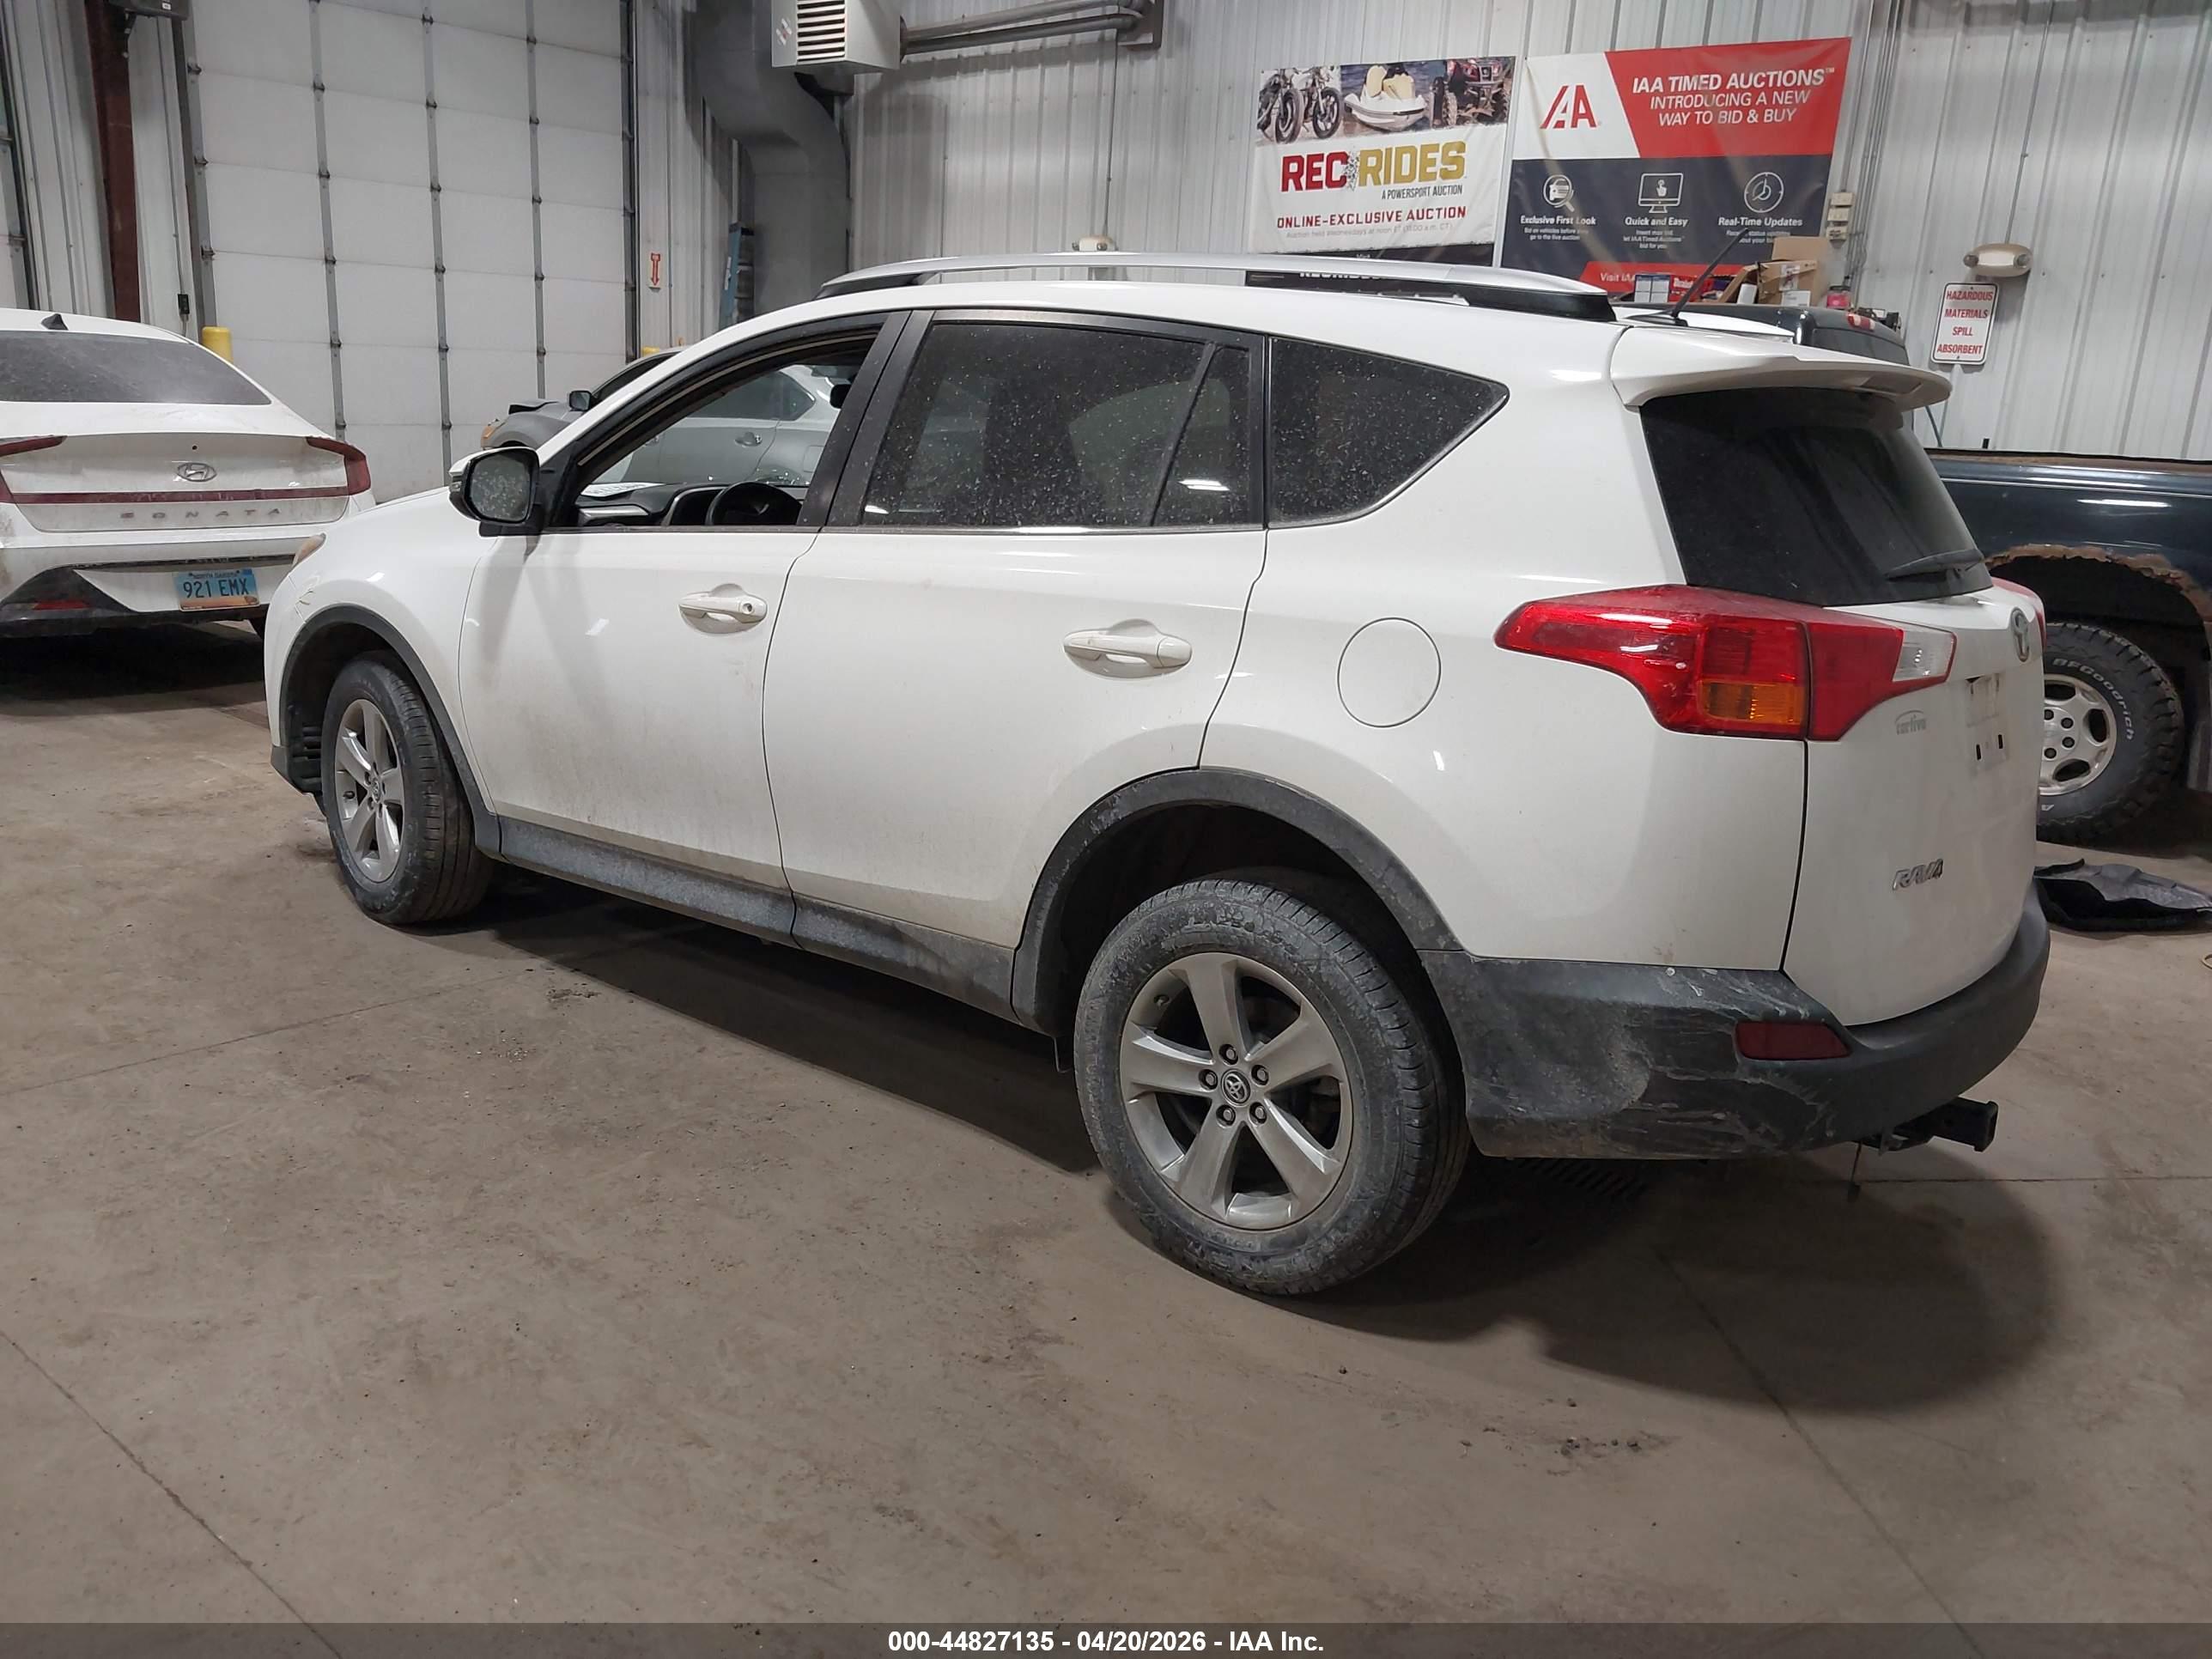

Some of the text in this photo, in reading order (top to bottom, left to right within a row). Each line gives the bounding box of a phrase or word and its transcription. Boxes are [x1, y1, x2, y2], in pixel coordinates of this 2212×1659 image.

[1632, 76, 1664, 94] IAA
[1668, 74, 1723, 92] TIMED
[1650, 89, 1812, 110] INTRODUCING A NEW
[1659, 107, 1797, 126] WAY TO BID & BUY
[1281, 141, 1468, 192] REC RIDES
[1387, 186, 1431, 200] POWERSPORT
[1432, 185, 1463, 197] AUCTION
[1277, 209, 1402, 229] ONLINE-EXCLUSIVE
[1405, 205, 1468, 222] AUCTION
[1520, 216, 1596, 225] Exclusive First Look
[1625, 216, 1688, 228] Quick and Easy
[1718, 216, 1803, 228] Real-Time Updates
[1600, 272, 1620, 283] Visit
[1946, 290, 1993, 301] HAZARDOUS
[1944, 308, 1989, 319] MATERIALS
[1952, 326, 1973, 337] SPILL
[1936, 344, 1984, 355] ABSORBENT
[120, 507, 281, 520] SONATA
[183, 577, 250, 599] 921 EMX
[2051, 657, 2136, 741] BFGoodrich
[1892, 858, 1944, 891] RAV4
